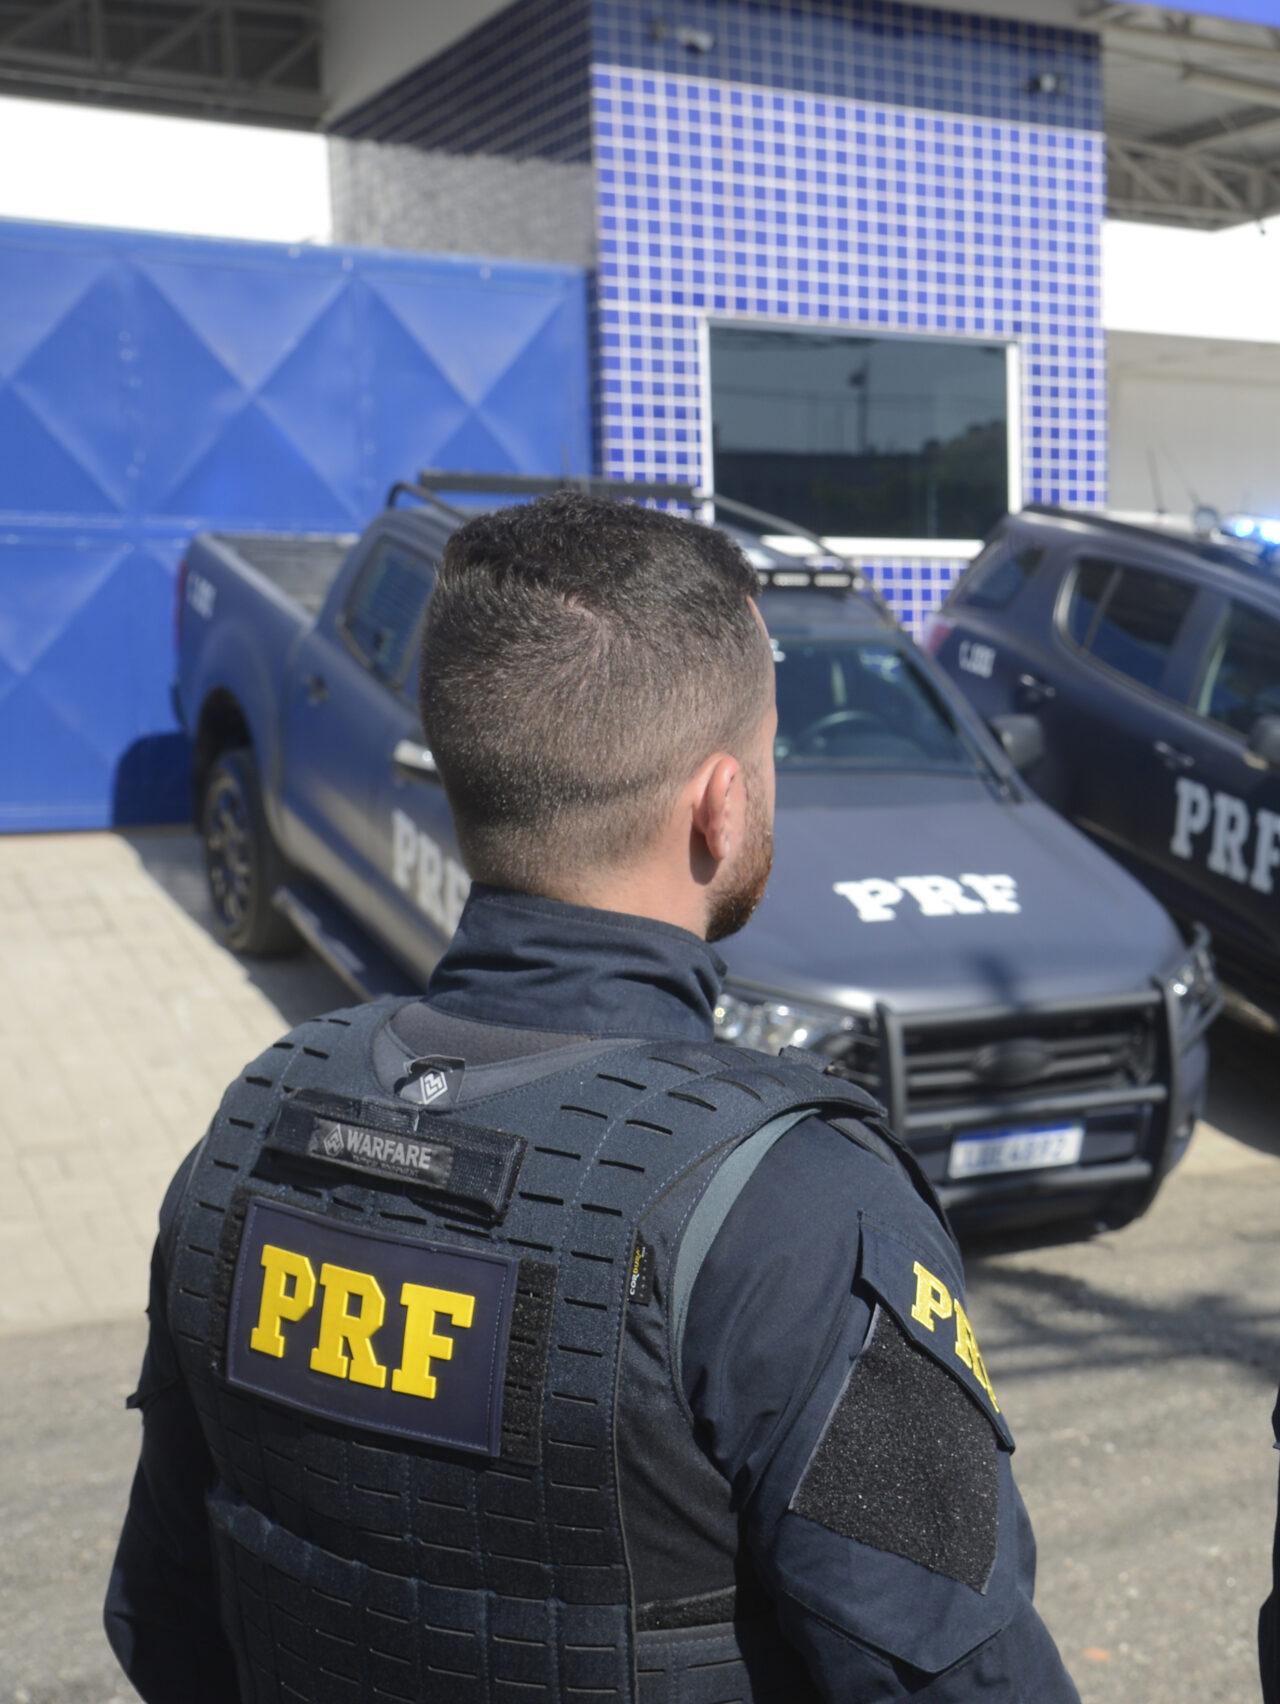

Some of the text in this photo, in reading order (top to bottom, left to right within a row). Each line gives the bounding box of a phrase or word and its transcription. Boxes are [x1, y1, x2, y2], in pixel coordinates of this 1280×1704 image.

[833, 873, 1021, 921] PRF
[346, 1129, 432, 1170] WARFARE
[250, 1244, 475, 1399] PRF
[911, 1260, 1001, 1413] PR
